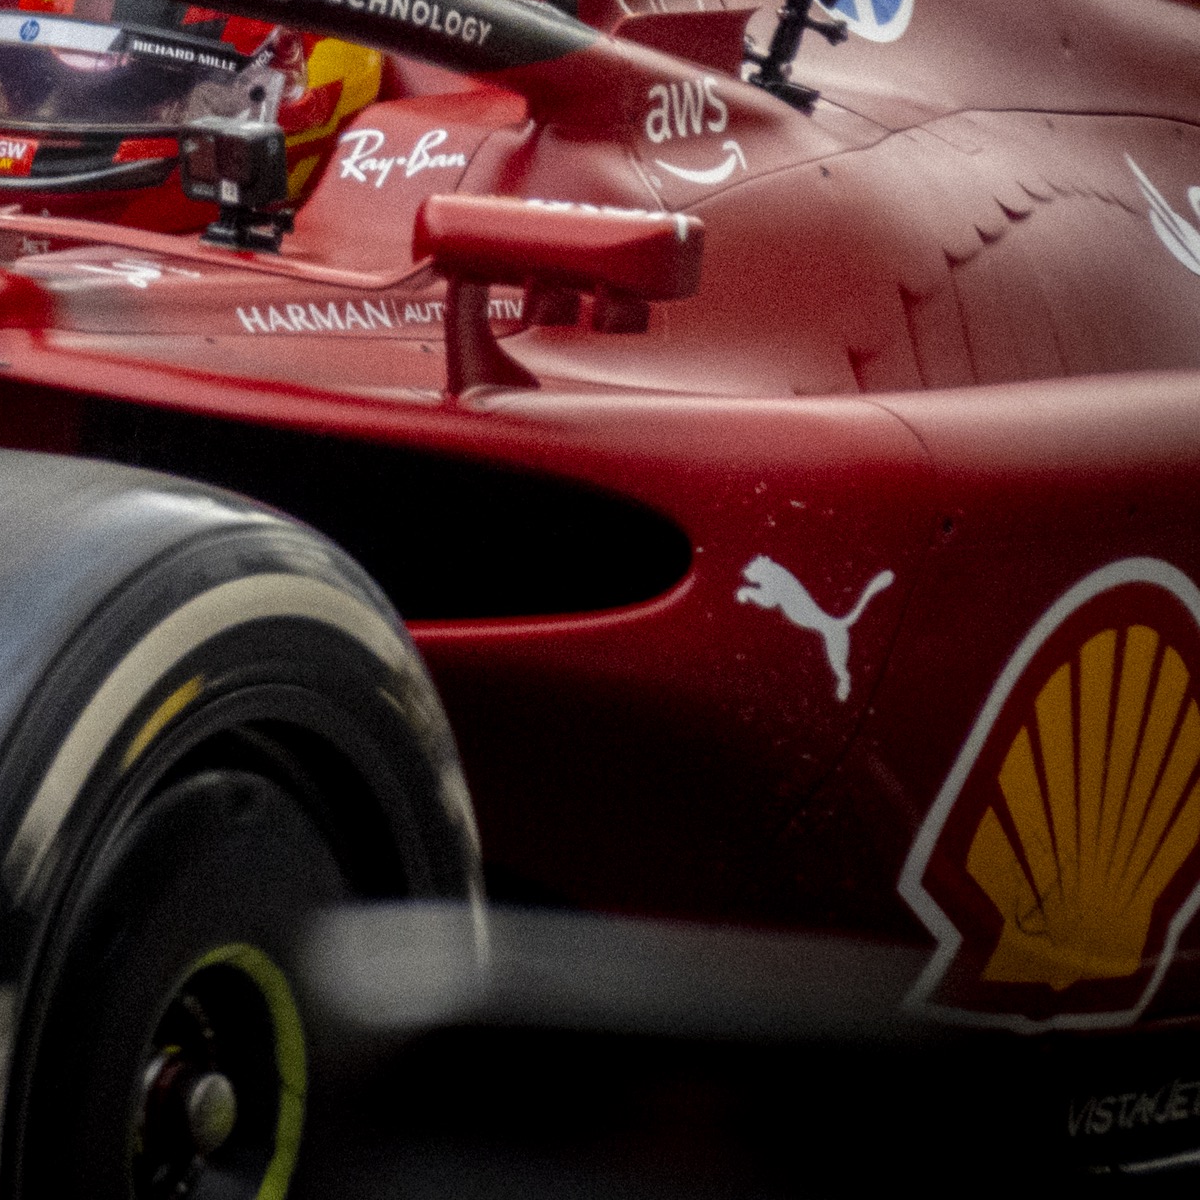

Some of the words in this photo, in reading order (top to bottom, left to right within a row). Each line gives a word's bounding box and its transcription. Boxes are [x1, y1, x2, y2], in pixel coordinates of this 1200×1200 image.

[133, 39, 195, 62] RICHARD
[198, 52, 237, 72] MILLE
[646, 75, 729, 144] aws
[339, 129, 467, 189] Ray-Ban
[236, 300, 394, 333] HARMAN
[1067, 1076, 1200, 1138] VISTAJE
